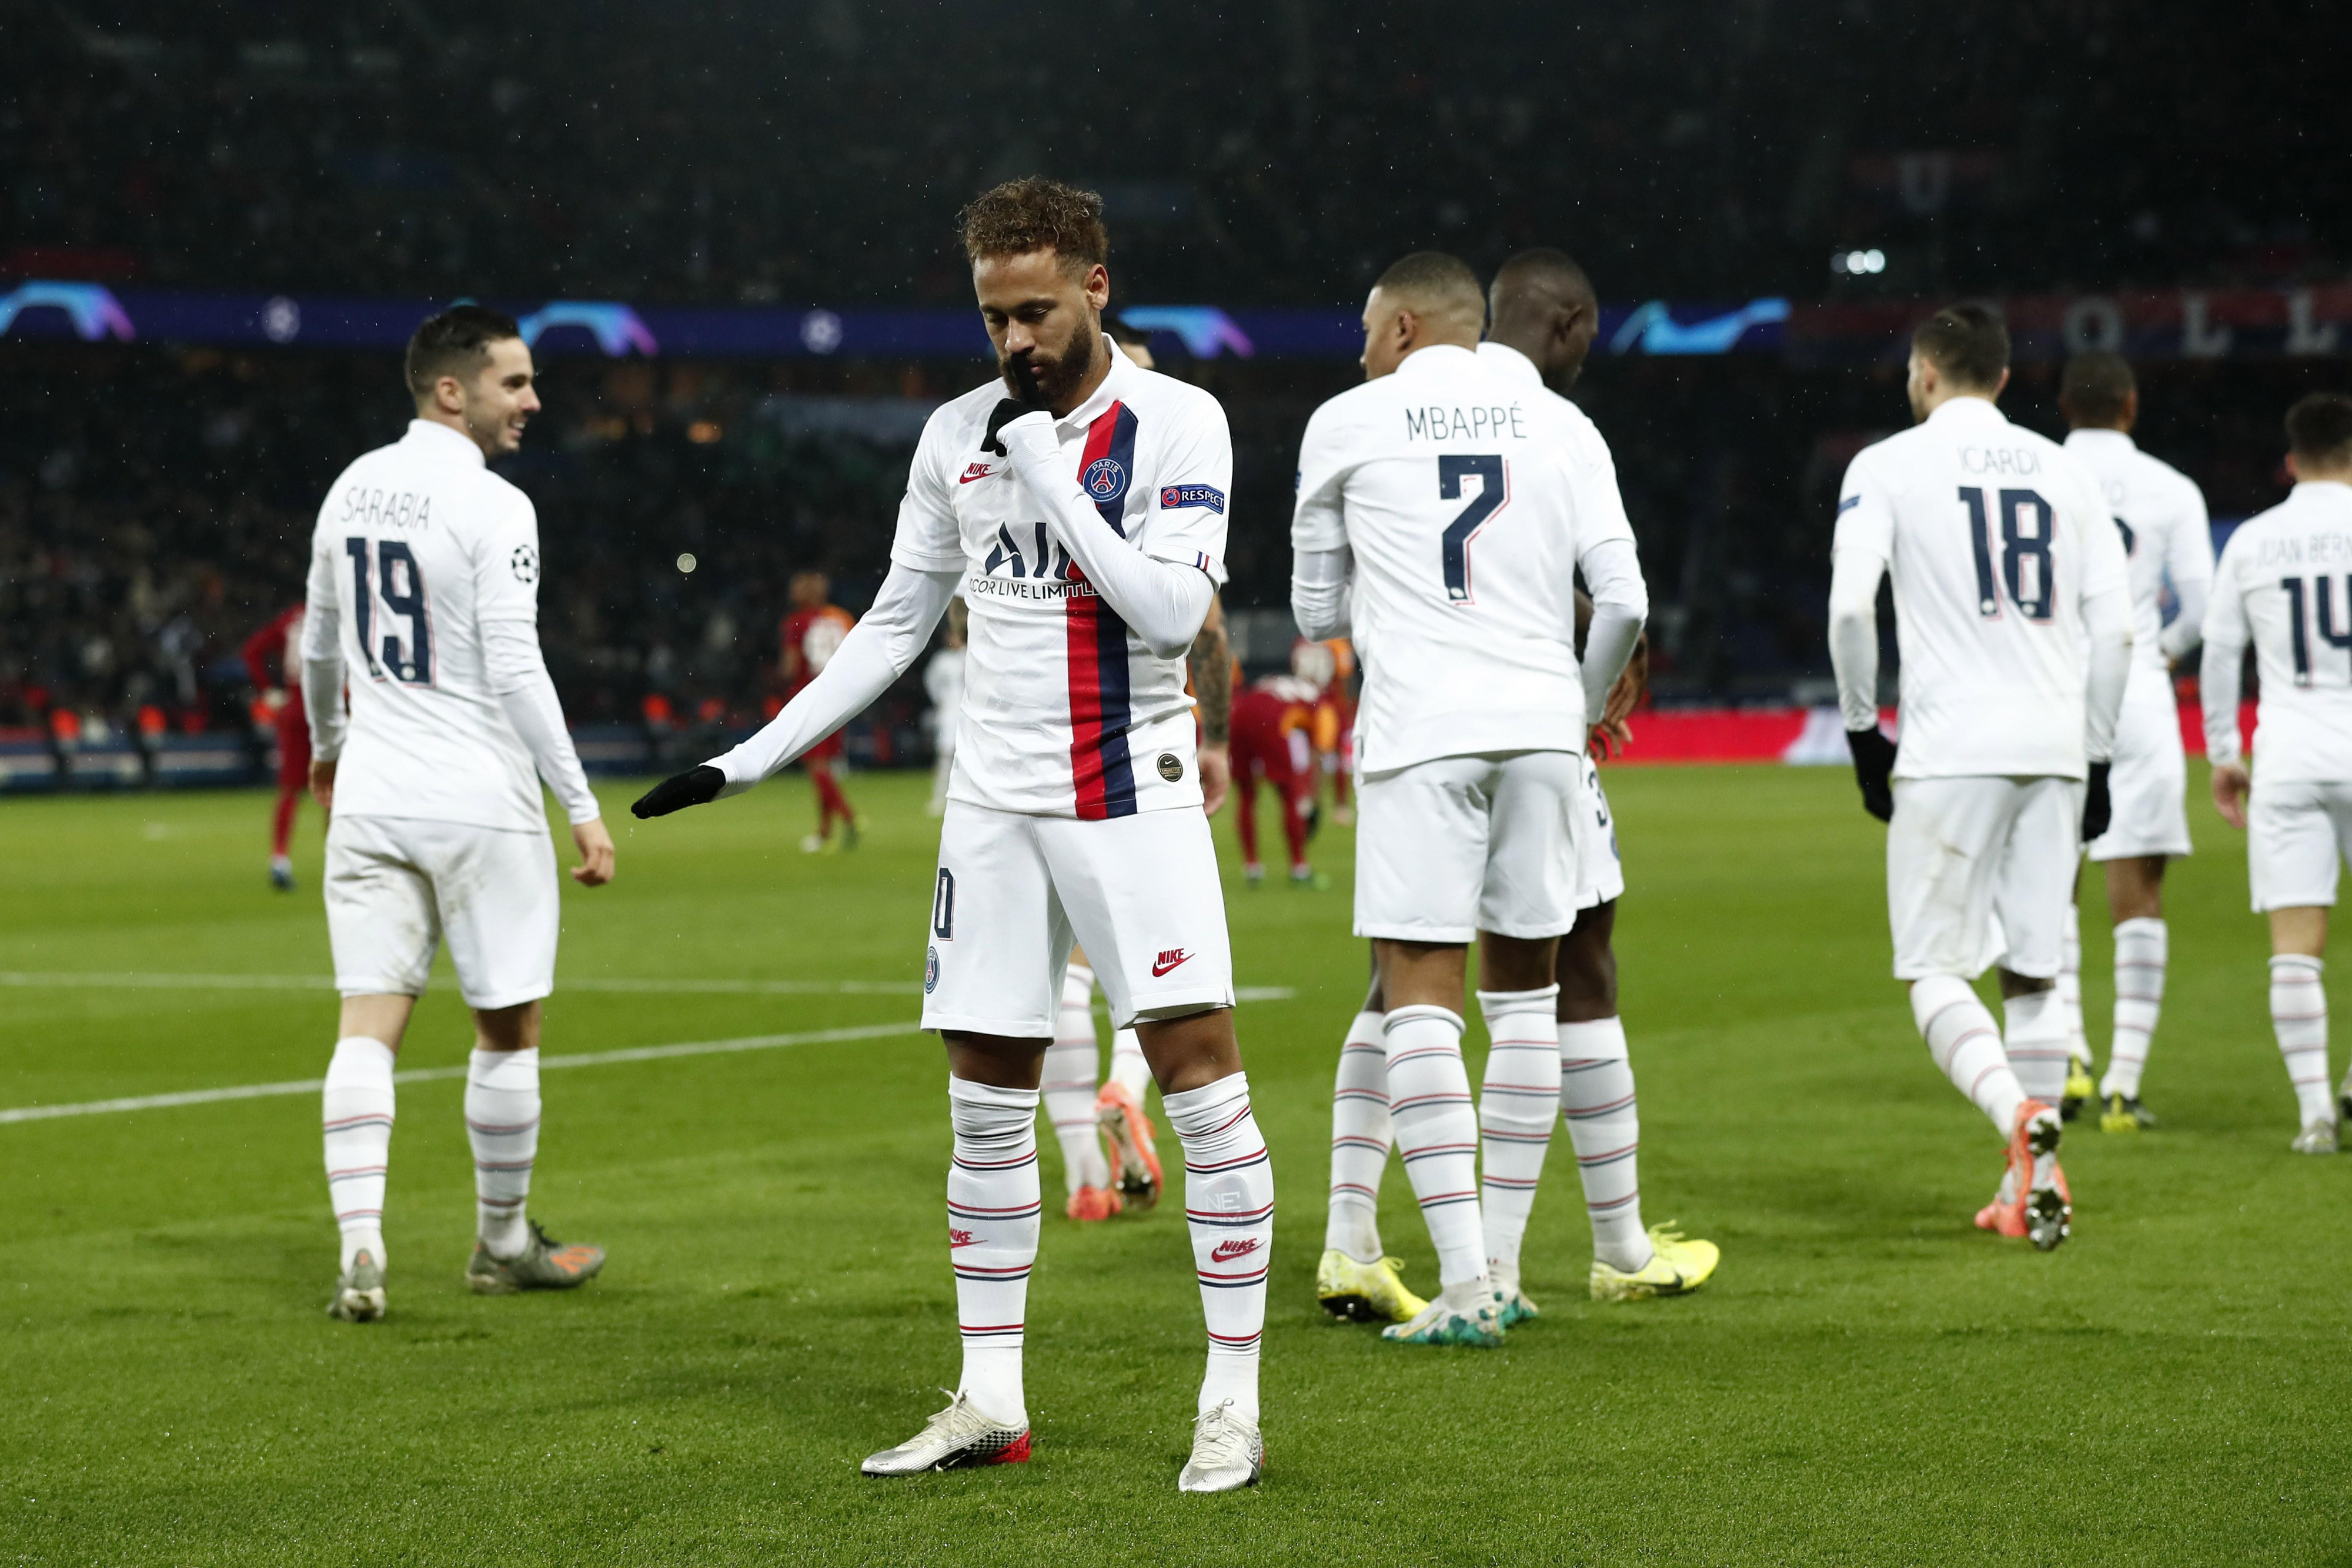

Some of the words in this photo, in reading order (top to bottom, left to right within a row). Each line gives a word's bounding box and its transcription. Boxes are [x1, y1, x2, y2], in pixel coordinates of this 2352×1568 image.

[1406, 402, 1527, 441] MBAPPÉ
[965, 462, 991, 475] NIKE
[1092, 461, 1120, 473] PARIS
[1957, 446, 2042, 475] ICARDI
[341, 486, 431, 530] SARABIA
[1182, 490, 1224, 507] RESPECT
[1438, 454, 1511, 606] 7
[1958, 486, 2056, 624] 18
[970, 579, 995, 594] COR
[998, 581, 1028, 598] LIVE
[346, 537, 436, 689] 19
[2281, 574, 2352, 690] 14
[1158, 948, 1185, 965] NIKE
[1219, 1238, 1257, 1252] NIKE
